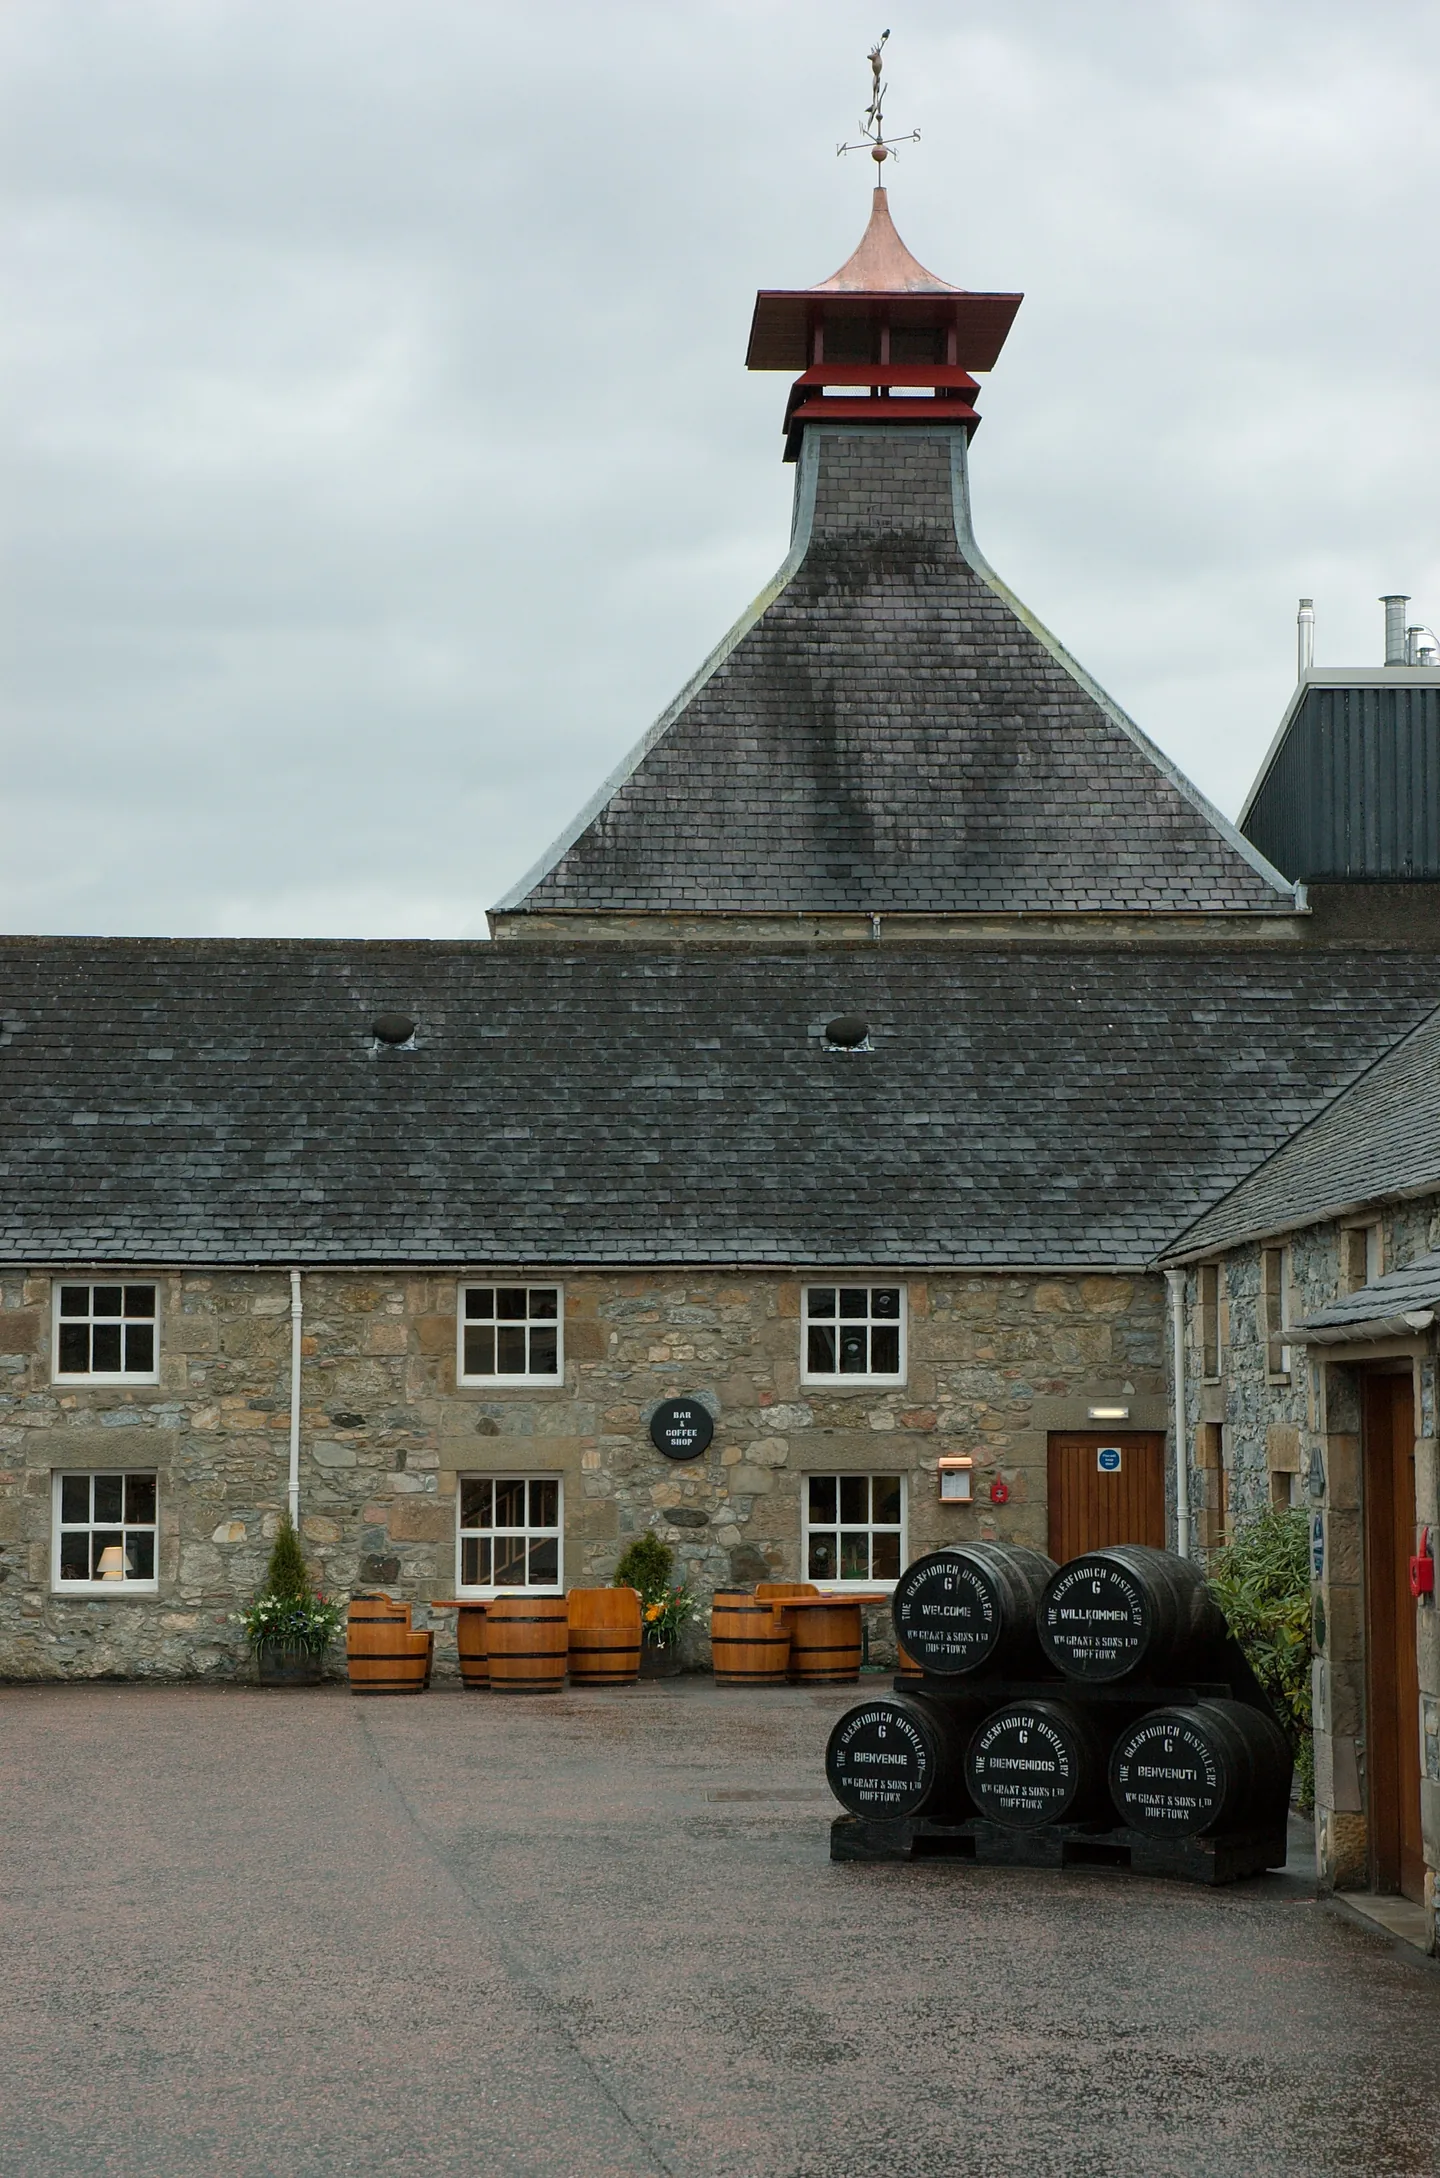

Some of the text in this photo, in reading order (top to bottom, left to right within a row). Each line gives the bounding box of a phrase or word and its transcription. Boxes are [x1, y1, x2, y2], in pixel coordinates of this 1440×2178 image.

[913, 128, 921, 143] S
[944, 1577, 952, 1590] G
[1092, 1581, 1100, 1594] G
[902, 1564, 992, 1622] THE GLENFIDDICH DISTILLERY
[1048, 1568, 1142, 1626] THE GLENFIDDICH DISTILLERY
[922, 1604, 971, 1617] WELCOME
[1061, 1609, 1128, 1620] WILLKOMMEN
[920, 1630, 944, 1641] GRANT
[946, 1632, 952, 1641] &
[953, 1632, 973, 1642] SONS
[1066, 1636, 1093, 1646] GRANT
[1095, 1637, 1100, 1646] &
[1102, 1637, 1122, 1647] SONS
[925, 1643, 967, 1654] DUFFTOWN
[1073, 1649, 1116, 1659] DUFFTOWN
[878, 1725, 886, 1738] G
[1019, 1730, 1028, 1743] G
[836, 1712, 926, 1771] THE GLENFIDDICH DISTILLERY
[976, 1717, 1069, 1777] THE GLENFIDDICH DISTILLERY
[1164, 1739, 1173, 1752] G
[854, 1752, 907, 1765] BIENVENUE
[1120, 1725, 1216, 1787] THE GLENFIDDICH DISTILLERY
[989, 1758, 1055, 1771] BIENVENIDOS
[1138, 1766, 1197, 1780] BENVENUTI
[854, 1778, 878, 1789] GRANT
[880, 1780, 885, 1789] &
[887, 1780, 907, 1790] SONS
[993, 1784, 1020, 1795] GRANT
[1021, 1786, 1027, 1796] &
[1029, 1787, 1050, 1797] SONS
[860, 1791, 901, 1802] DUFFTOWN
[1000, 1797, 1043, 1809] DUFFTOWN
[1138, 1793, 1165, 1805] GRANT
[1167, 1796, 1172, 1806] &
[1174, 1796, 1196, 1807] SONS
[1145, 1807, 1189, 1820] DUFFTOWN
